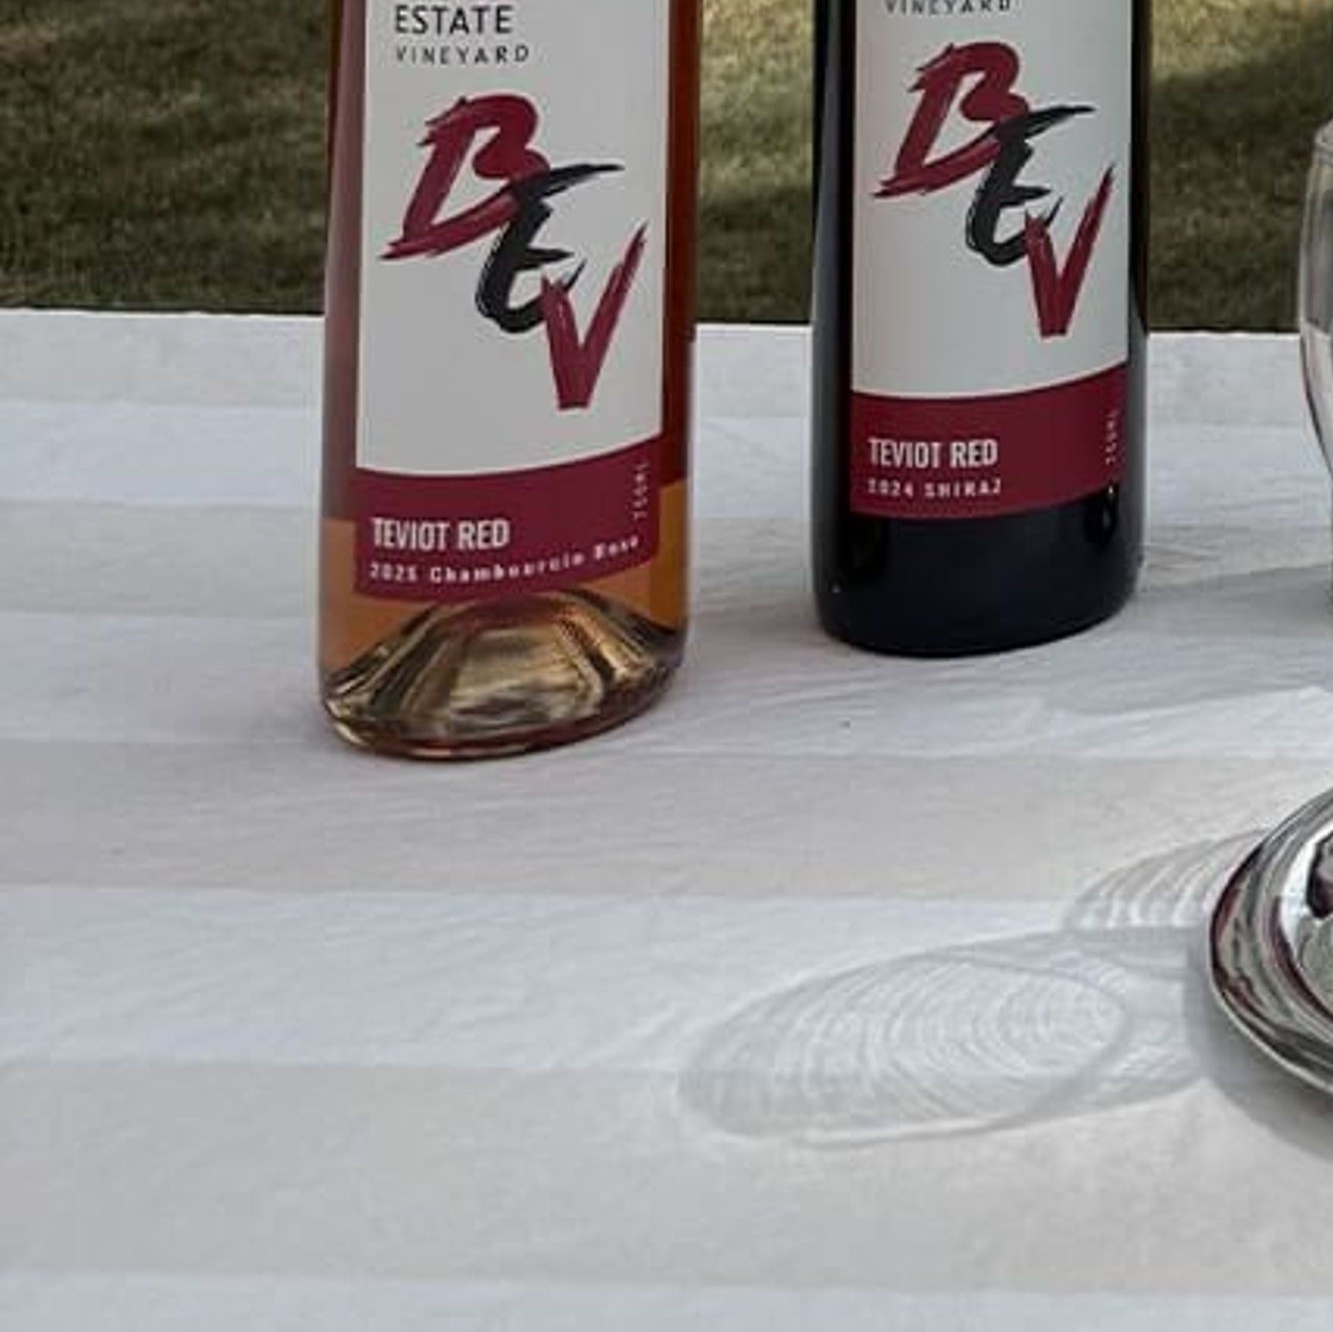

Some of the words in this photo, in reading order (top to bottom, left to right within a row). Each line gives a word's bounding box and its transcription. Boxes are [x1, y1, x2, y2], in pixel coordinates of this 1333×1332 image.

[394, 5, 514, 35] ESTATE
[396, 44, 530, 64] VINEYARD
[867, 437, 942, 468] TEVIOT
[950, 439, 998, 467] RED
[924, 478, 1001, 498] SHIRAZ
[372, 518, 449, 551] TEVIOT
[457, 519, 510, 550] RED
